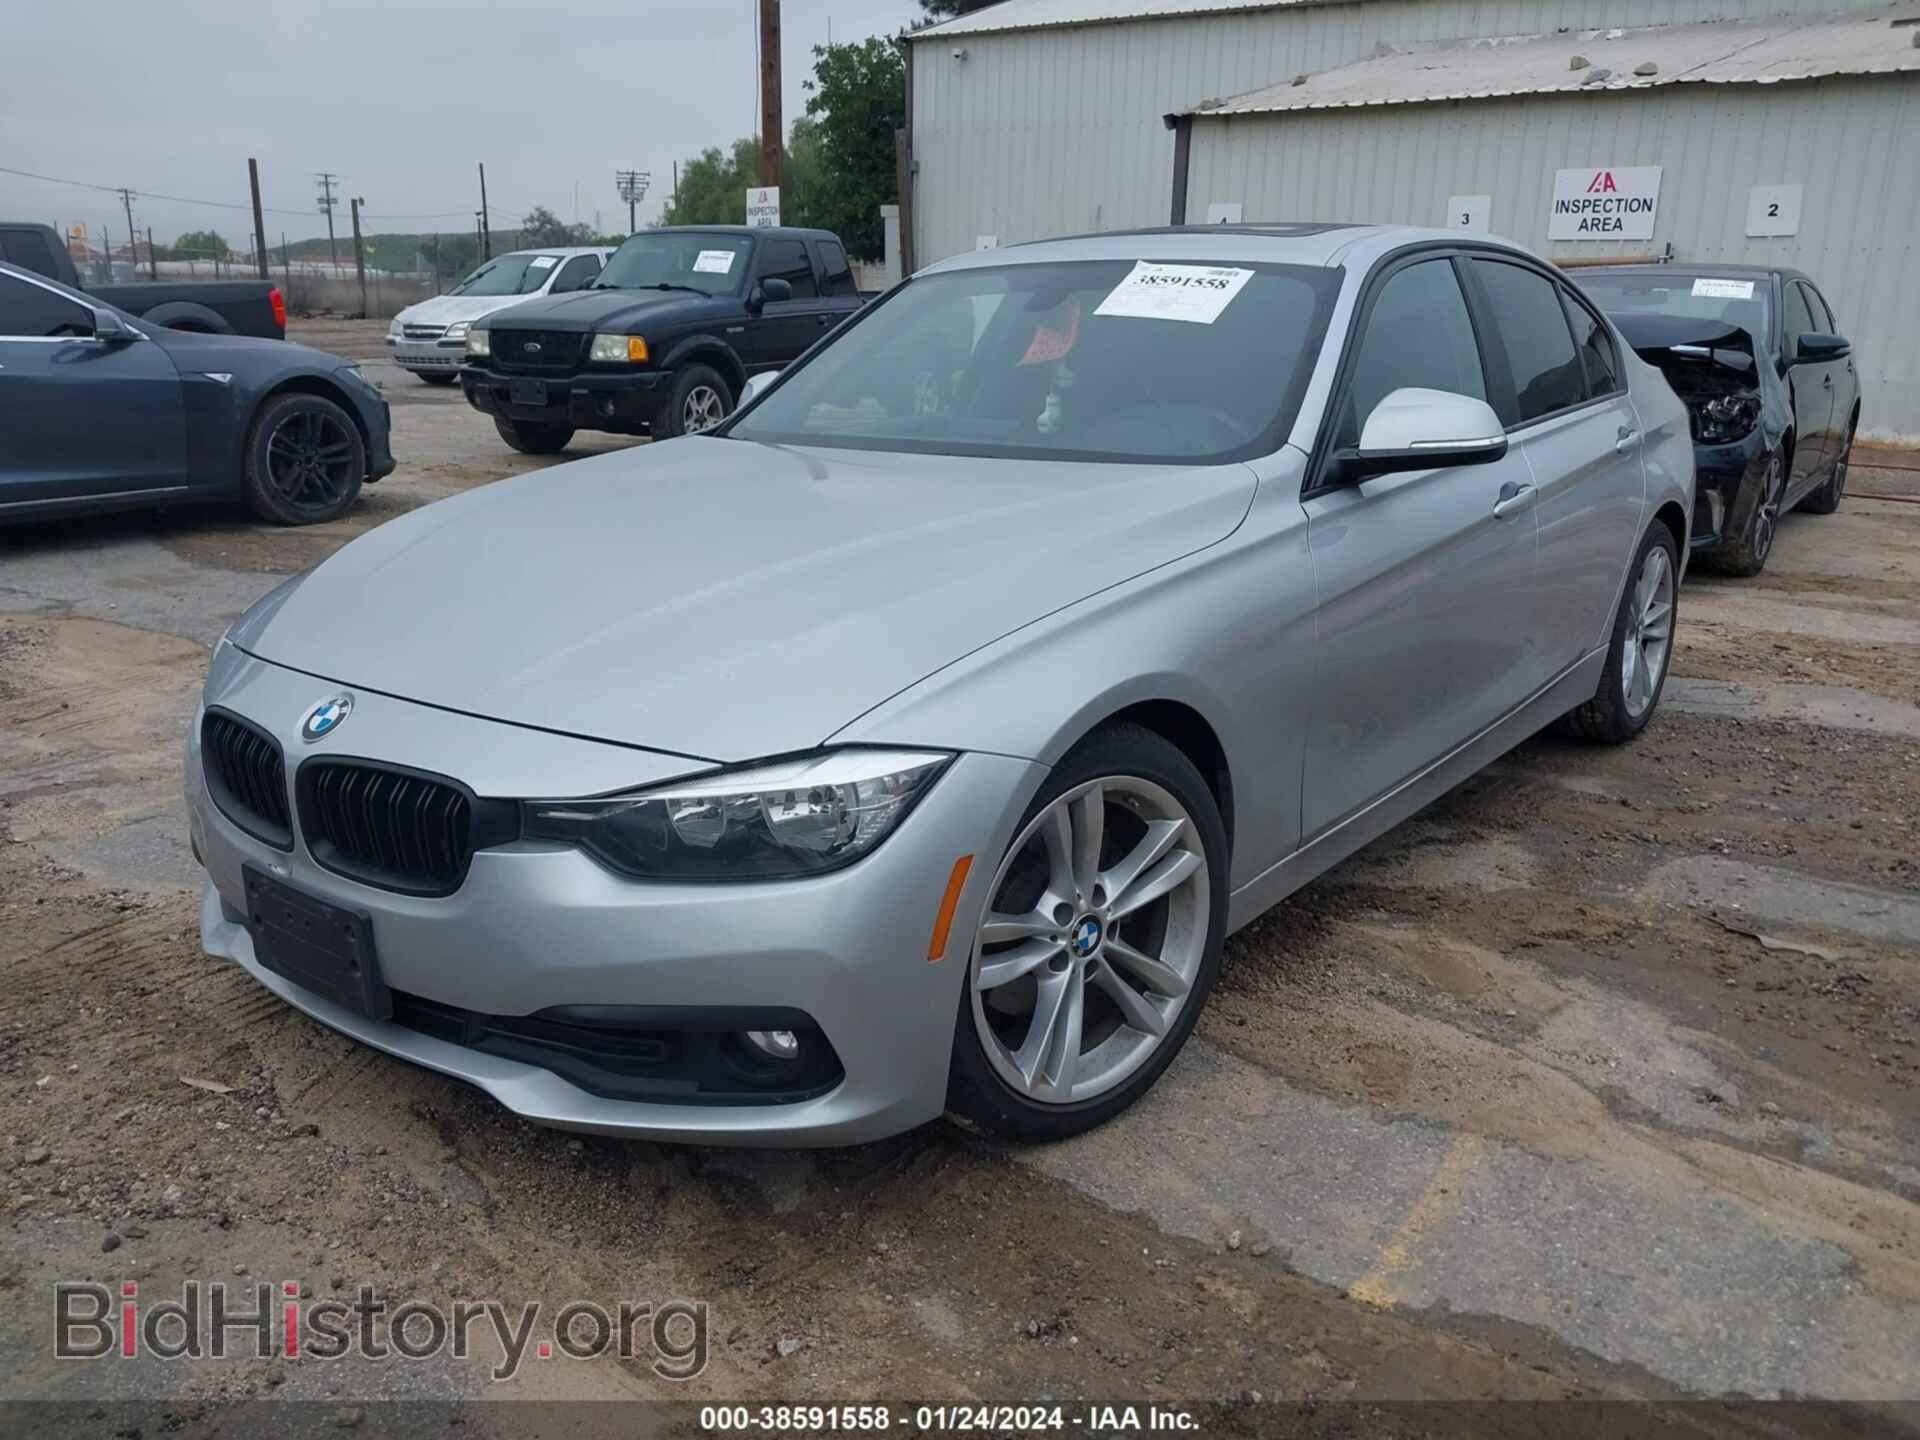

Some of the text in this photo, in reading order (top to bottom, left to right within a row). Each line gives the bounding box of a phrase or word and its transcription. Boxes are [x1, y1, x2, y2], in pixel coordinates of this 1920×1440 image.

[1554, 197, 1654, 214] INSPECTION
[1768, 203, 1779, 217] 2
[1462, 212, 1470, 225] 3
[1577, 216, 1624, 232] AREA
